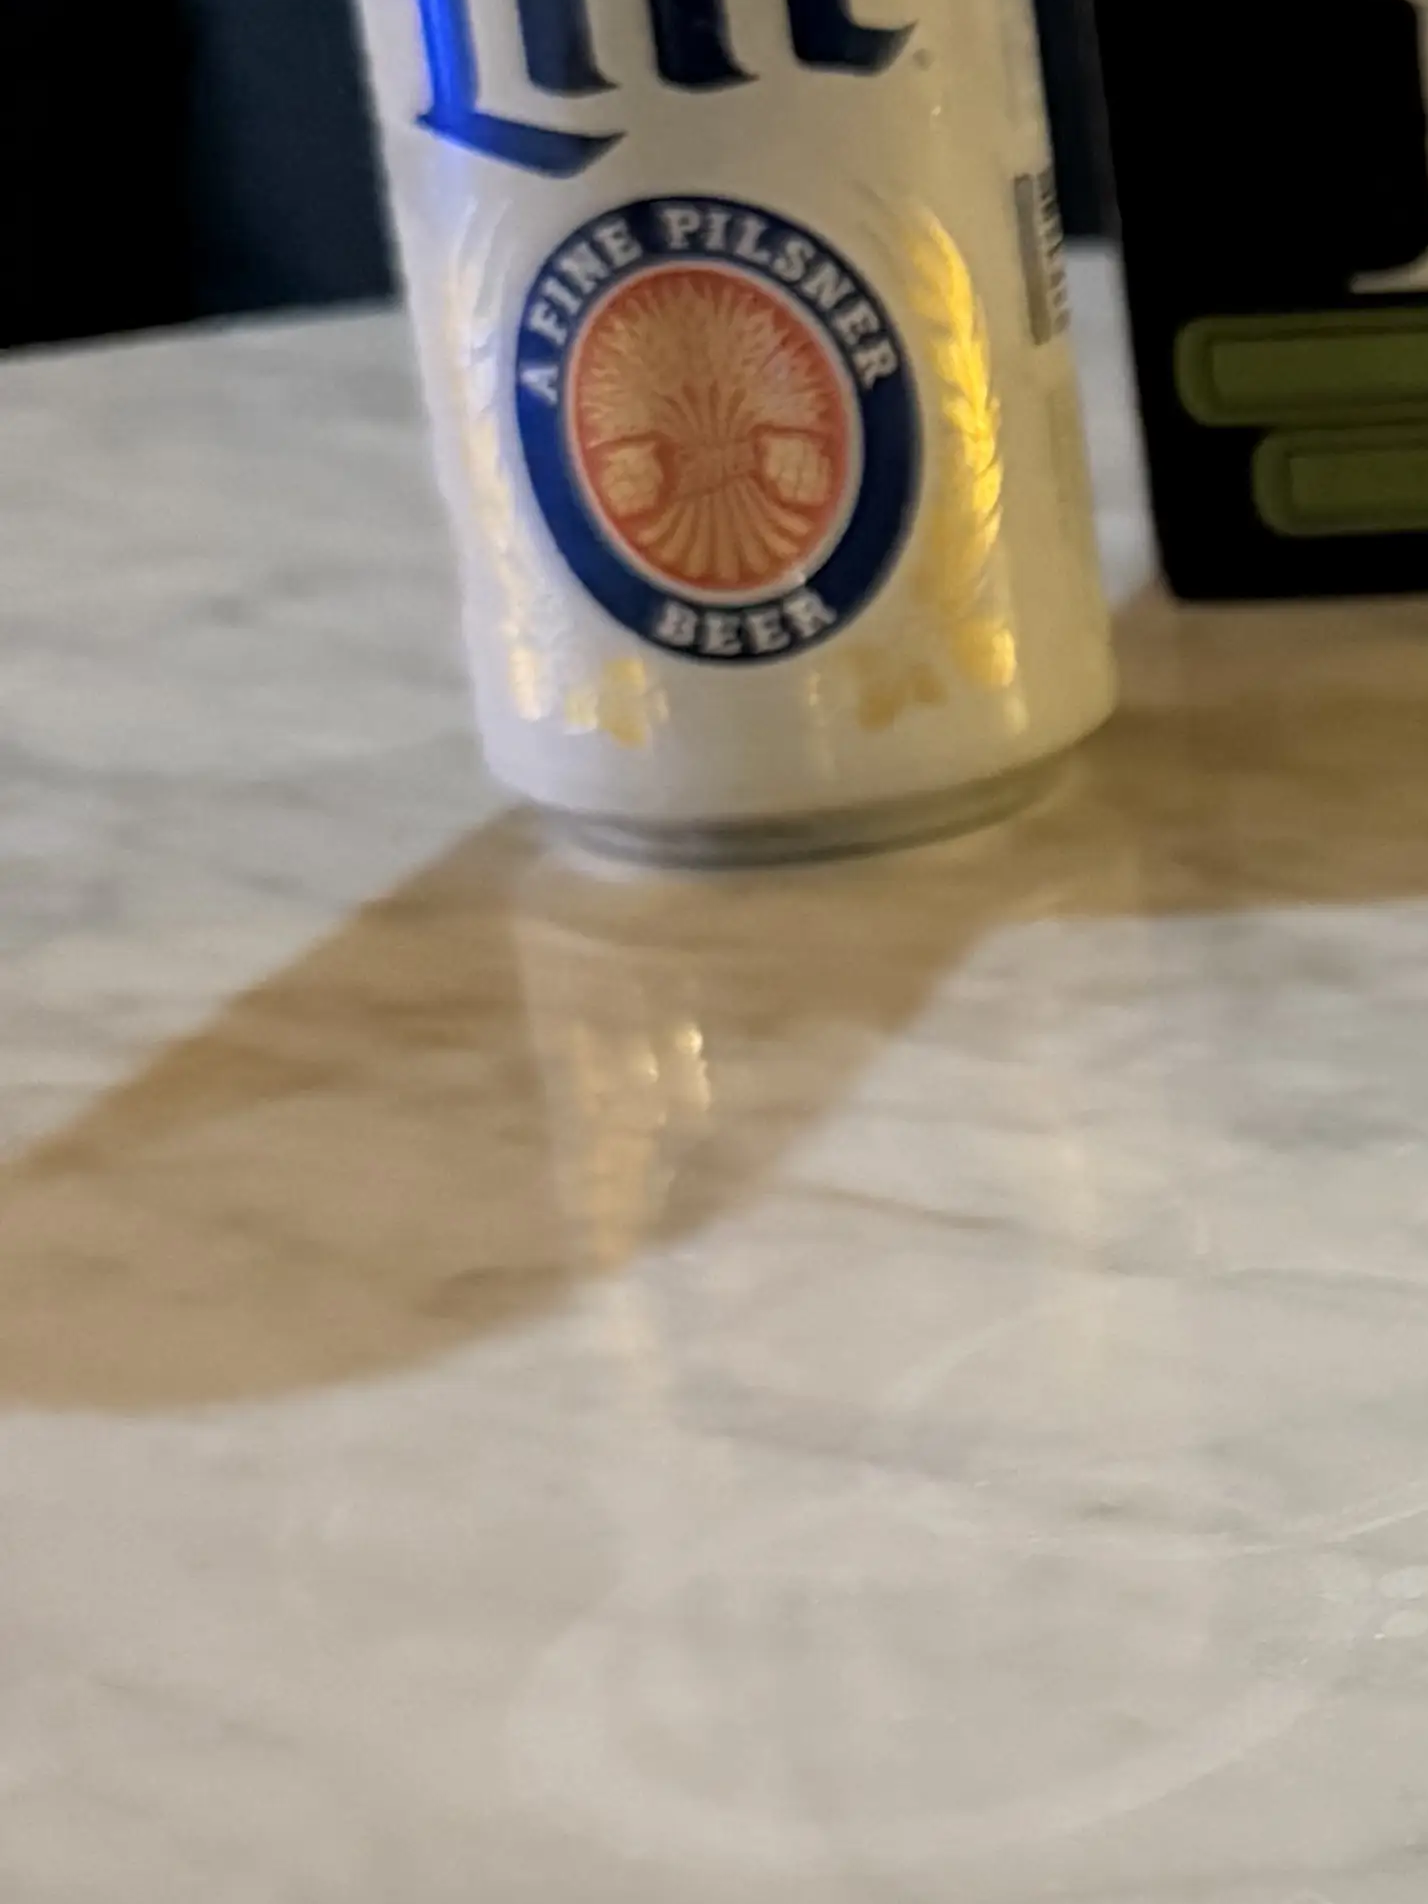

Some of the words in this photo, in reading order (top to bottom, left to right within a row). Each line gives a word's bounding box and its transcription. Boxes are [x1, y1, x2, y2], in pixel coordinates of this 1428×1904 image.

[530, 218, 643, 345] FINE
[661, 206, 899, 390] PILSNER
[520, 362, 559, 405] A
[656, 587, 838, 655] BEER
